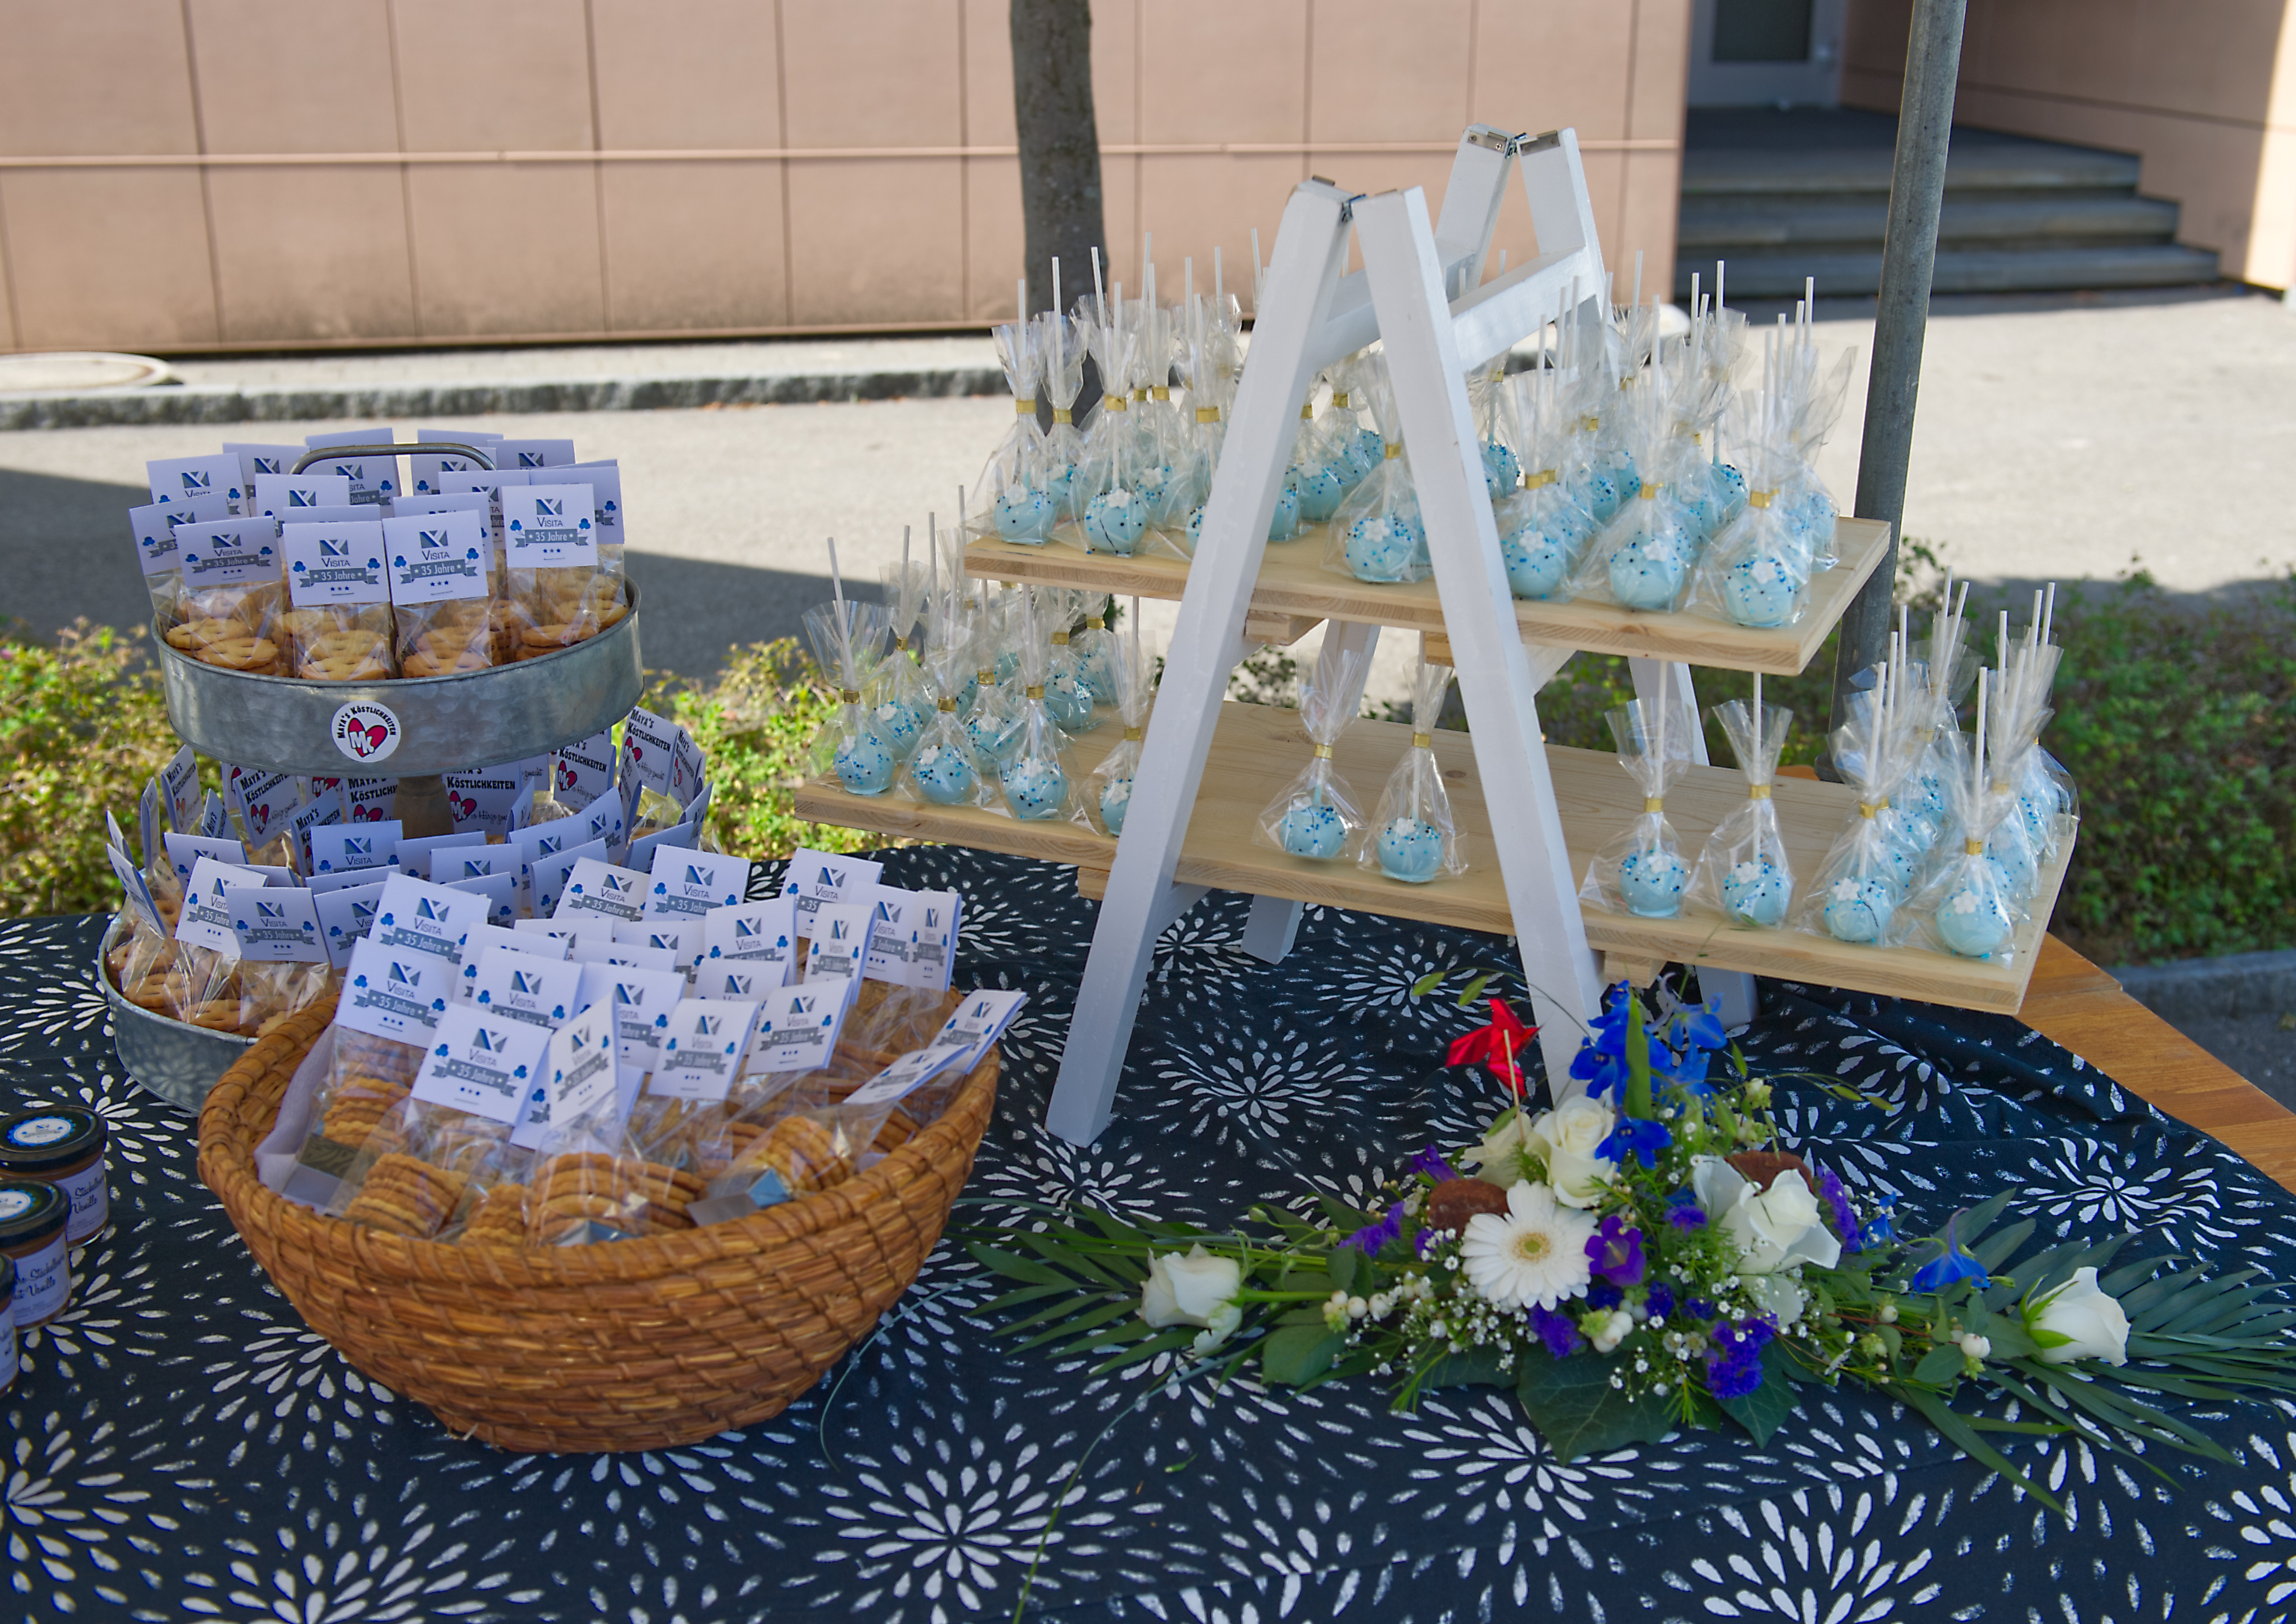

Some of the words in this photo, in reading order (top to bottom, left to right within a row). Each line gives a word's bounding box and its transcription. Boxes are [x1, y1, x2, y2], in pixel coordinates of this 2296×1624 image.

[537, 517, 563, 527] VISITA
[535, 532, 545, 541] 35
[548, 532, 567, 541] Jahre
[422, 550, 450, 560] VISITA
[321, 558, 350, 567] VISITA
[422, 566, 432, 575] 35
[434, 563, 455, 574] Jahre
[321, 571, 332, 581] 35
[334, 570, 355, 580] Jahre
[337, 712, 351, 738] MAYA'S
[350, 706, 396, 735] KÖSTLICHKEITEN
[630, 709, 654, 729] MAYA'S
[627, 722, 672, 751] KÖSTLICHKEITEN
[559, 748, 607, 772] KÖSTLICHKEITEN
[447, 776, 516, 790] KÖSTLICHKEITEN
[295, 808, 319, 831] MAYA'S
[346, 856, 372, 865] VISITA
[601, 888, 624, 903] VISITA
[684, 884, 709, 898] VISITA
[815, 885, 838, 899] VISITA
[592, 899, 603, 909] 35
[603, 901, 625, 915] Jahre
[677, 901, 687, 911] 35
[689, 903, 707, 914] Jahr
[806, 901, 817, 911] 35
[205, 911, 213, 920] 35
[260, 918, 287, 928] VISITA
[414, 918, 442, 935] VISITA
[275, 930, 295, 940] Jahre
[404, 933, 417, 945] 35
[418, 935, 441, 952] Jahre
[878, 939, 896, 954] Jahre
[387, 981, 414, 1000] VISITA
[378, 995, 391, 1008] 35
[393, 999, 415, 1015] Jahre
[509, 992, 536, 1009] VISITA
[469, 1049, 497, 1067] VISITA
[457, 1064, 469, 1078] 35
[471, 1067, 495, 1087] Jahre
